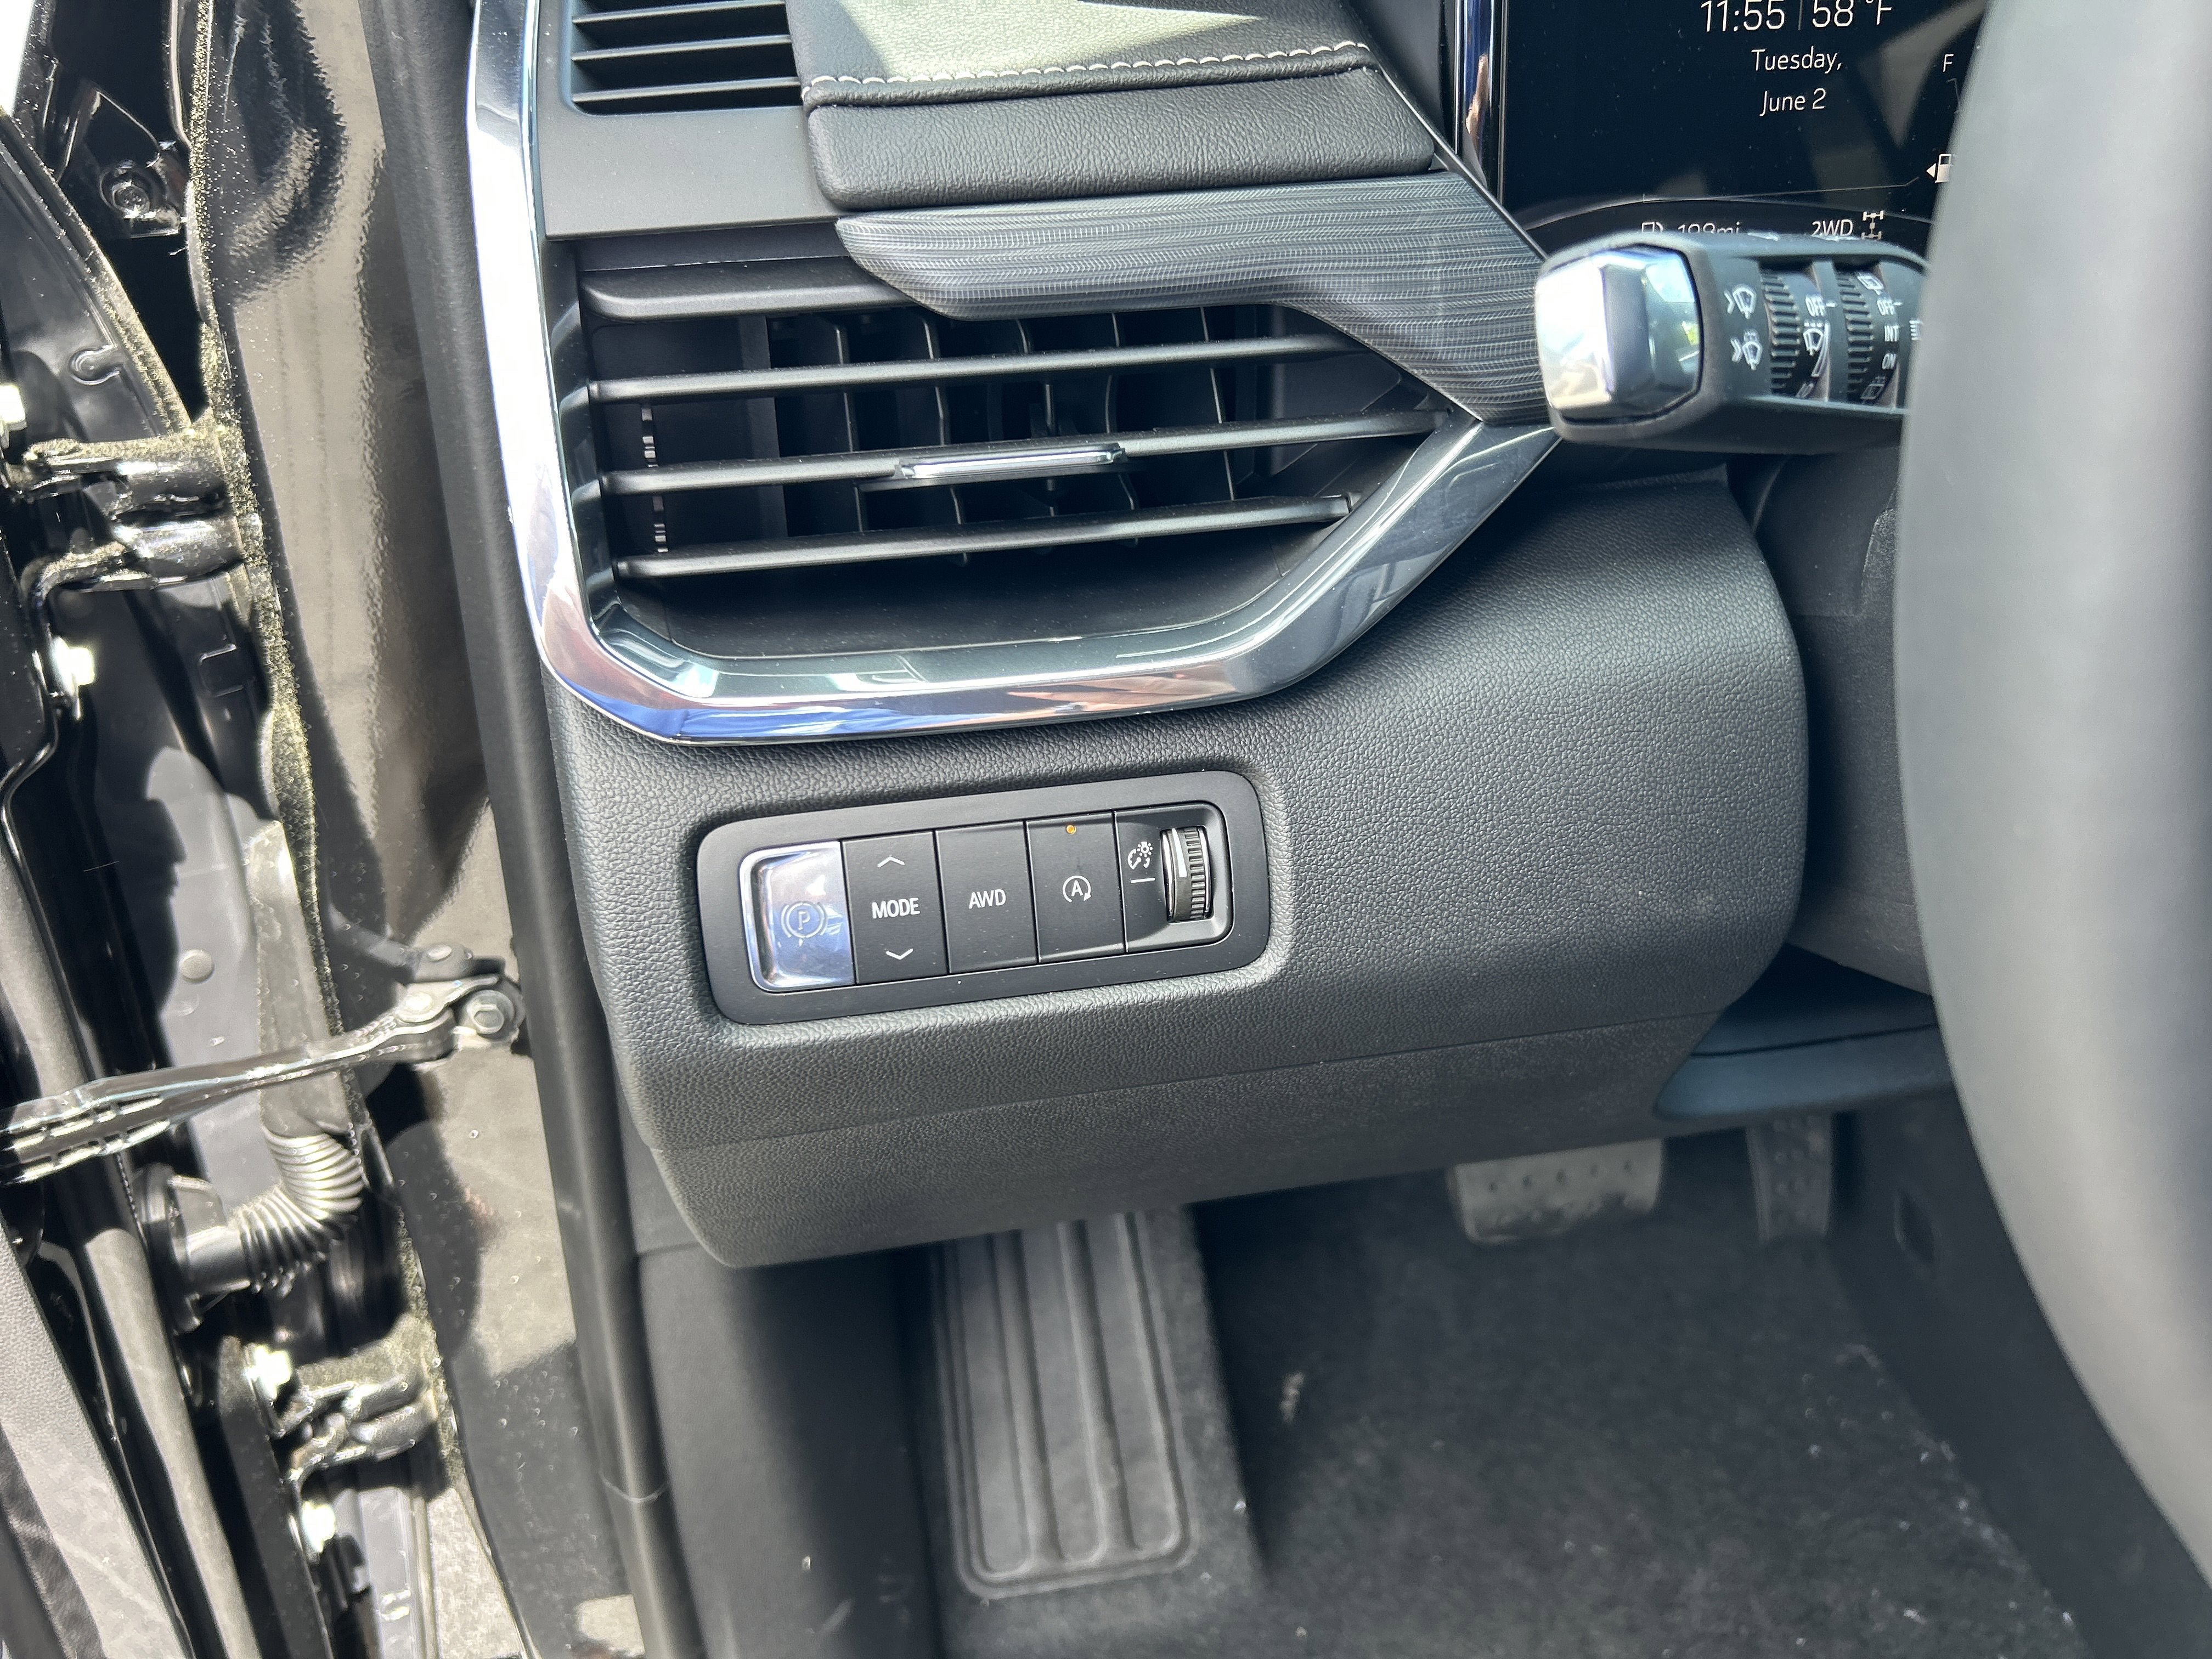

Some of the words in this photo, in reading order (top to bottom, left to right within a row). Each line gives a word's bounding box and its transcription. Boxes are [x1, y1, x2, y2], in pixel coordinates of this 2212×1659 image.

[1701, 0, 1785, 32] 11:55
[1812, 0, 1854, 27] 58
[1751, 46, 1842, 74] Tuesday,
[1943, 54, 1954, 72] F
[1759, 91, 1805, 116] June
[1812, 88, 1826, 109] 2
[1811, 219, 1853, 236] 2WD
[1805, 296, 1826, 317] OFF
[872, 898, 921, 919] MODE
[968, 889, 1007, 909] AWD
